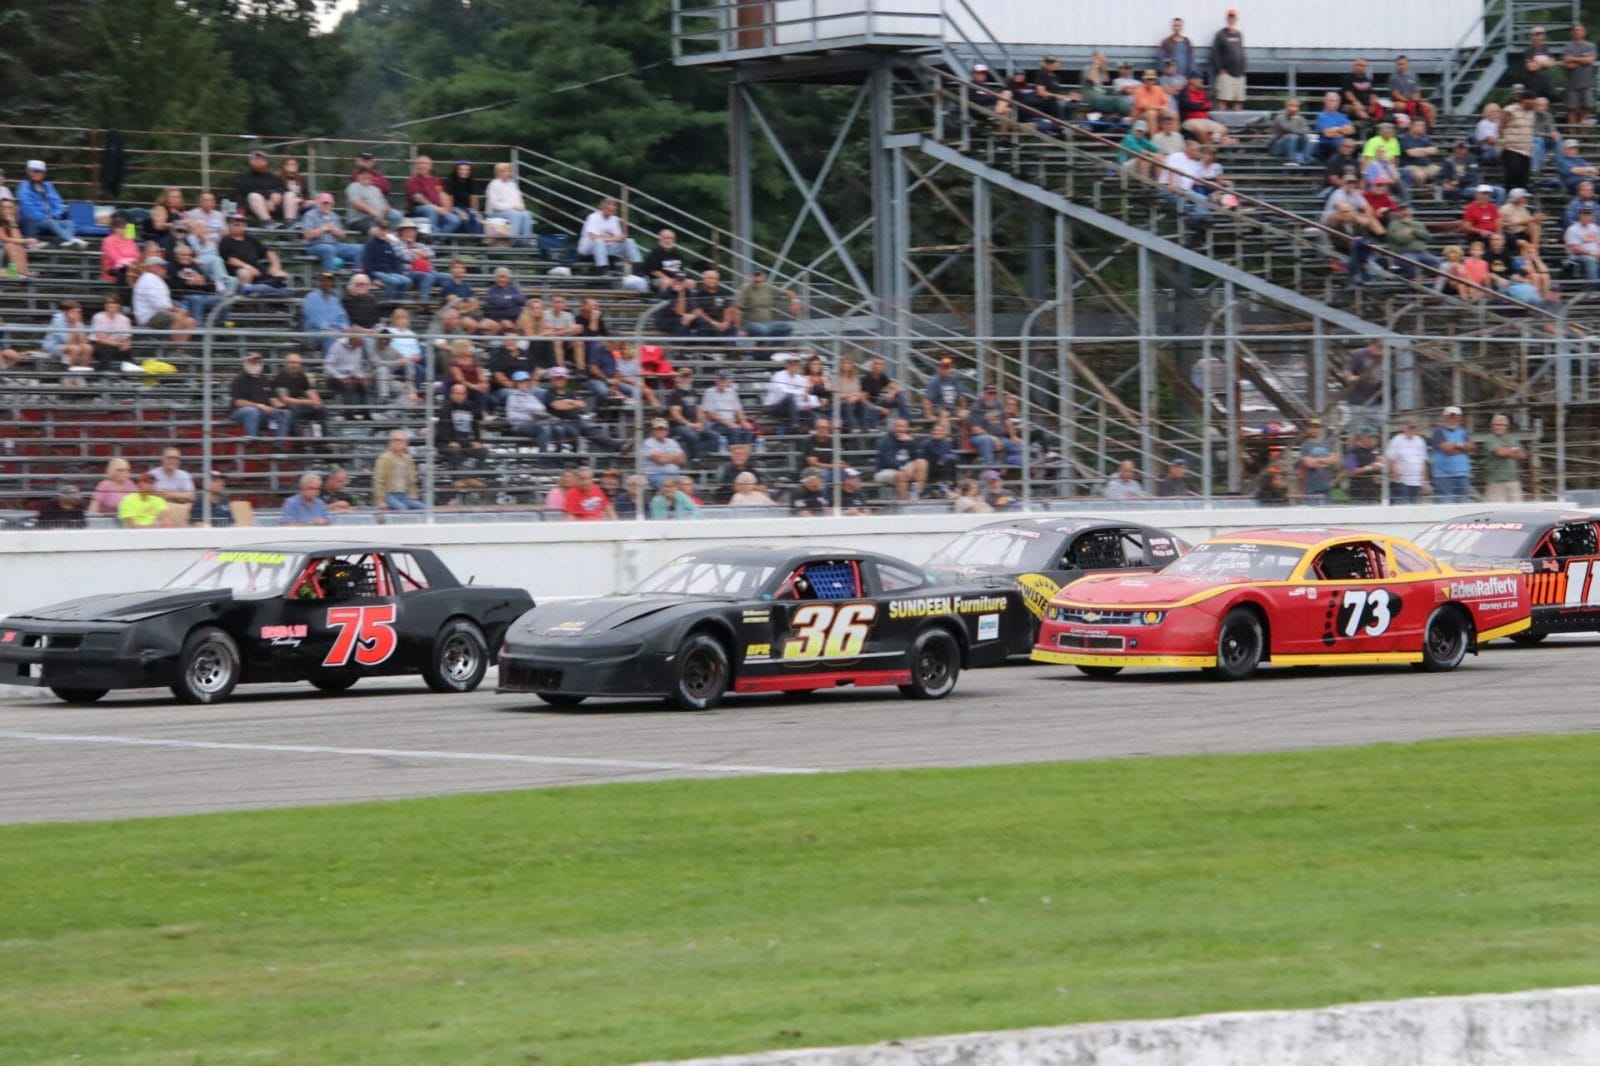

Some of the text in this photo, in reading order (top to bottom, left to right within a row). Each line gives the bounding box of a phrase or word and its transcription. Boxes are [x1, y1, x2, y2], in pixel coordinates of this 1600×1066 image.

[1446, 522, 1524, 530] FANNING
[889, 596, 1008, 619] SUNDEEN Furniture
[1343, 588, 1391, 637] 73
[321, 603, 397, 667] 75
[782, 602, 878, 664] 36
